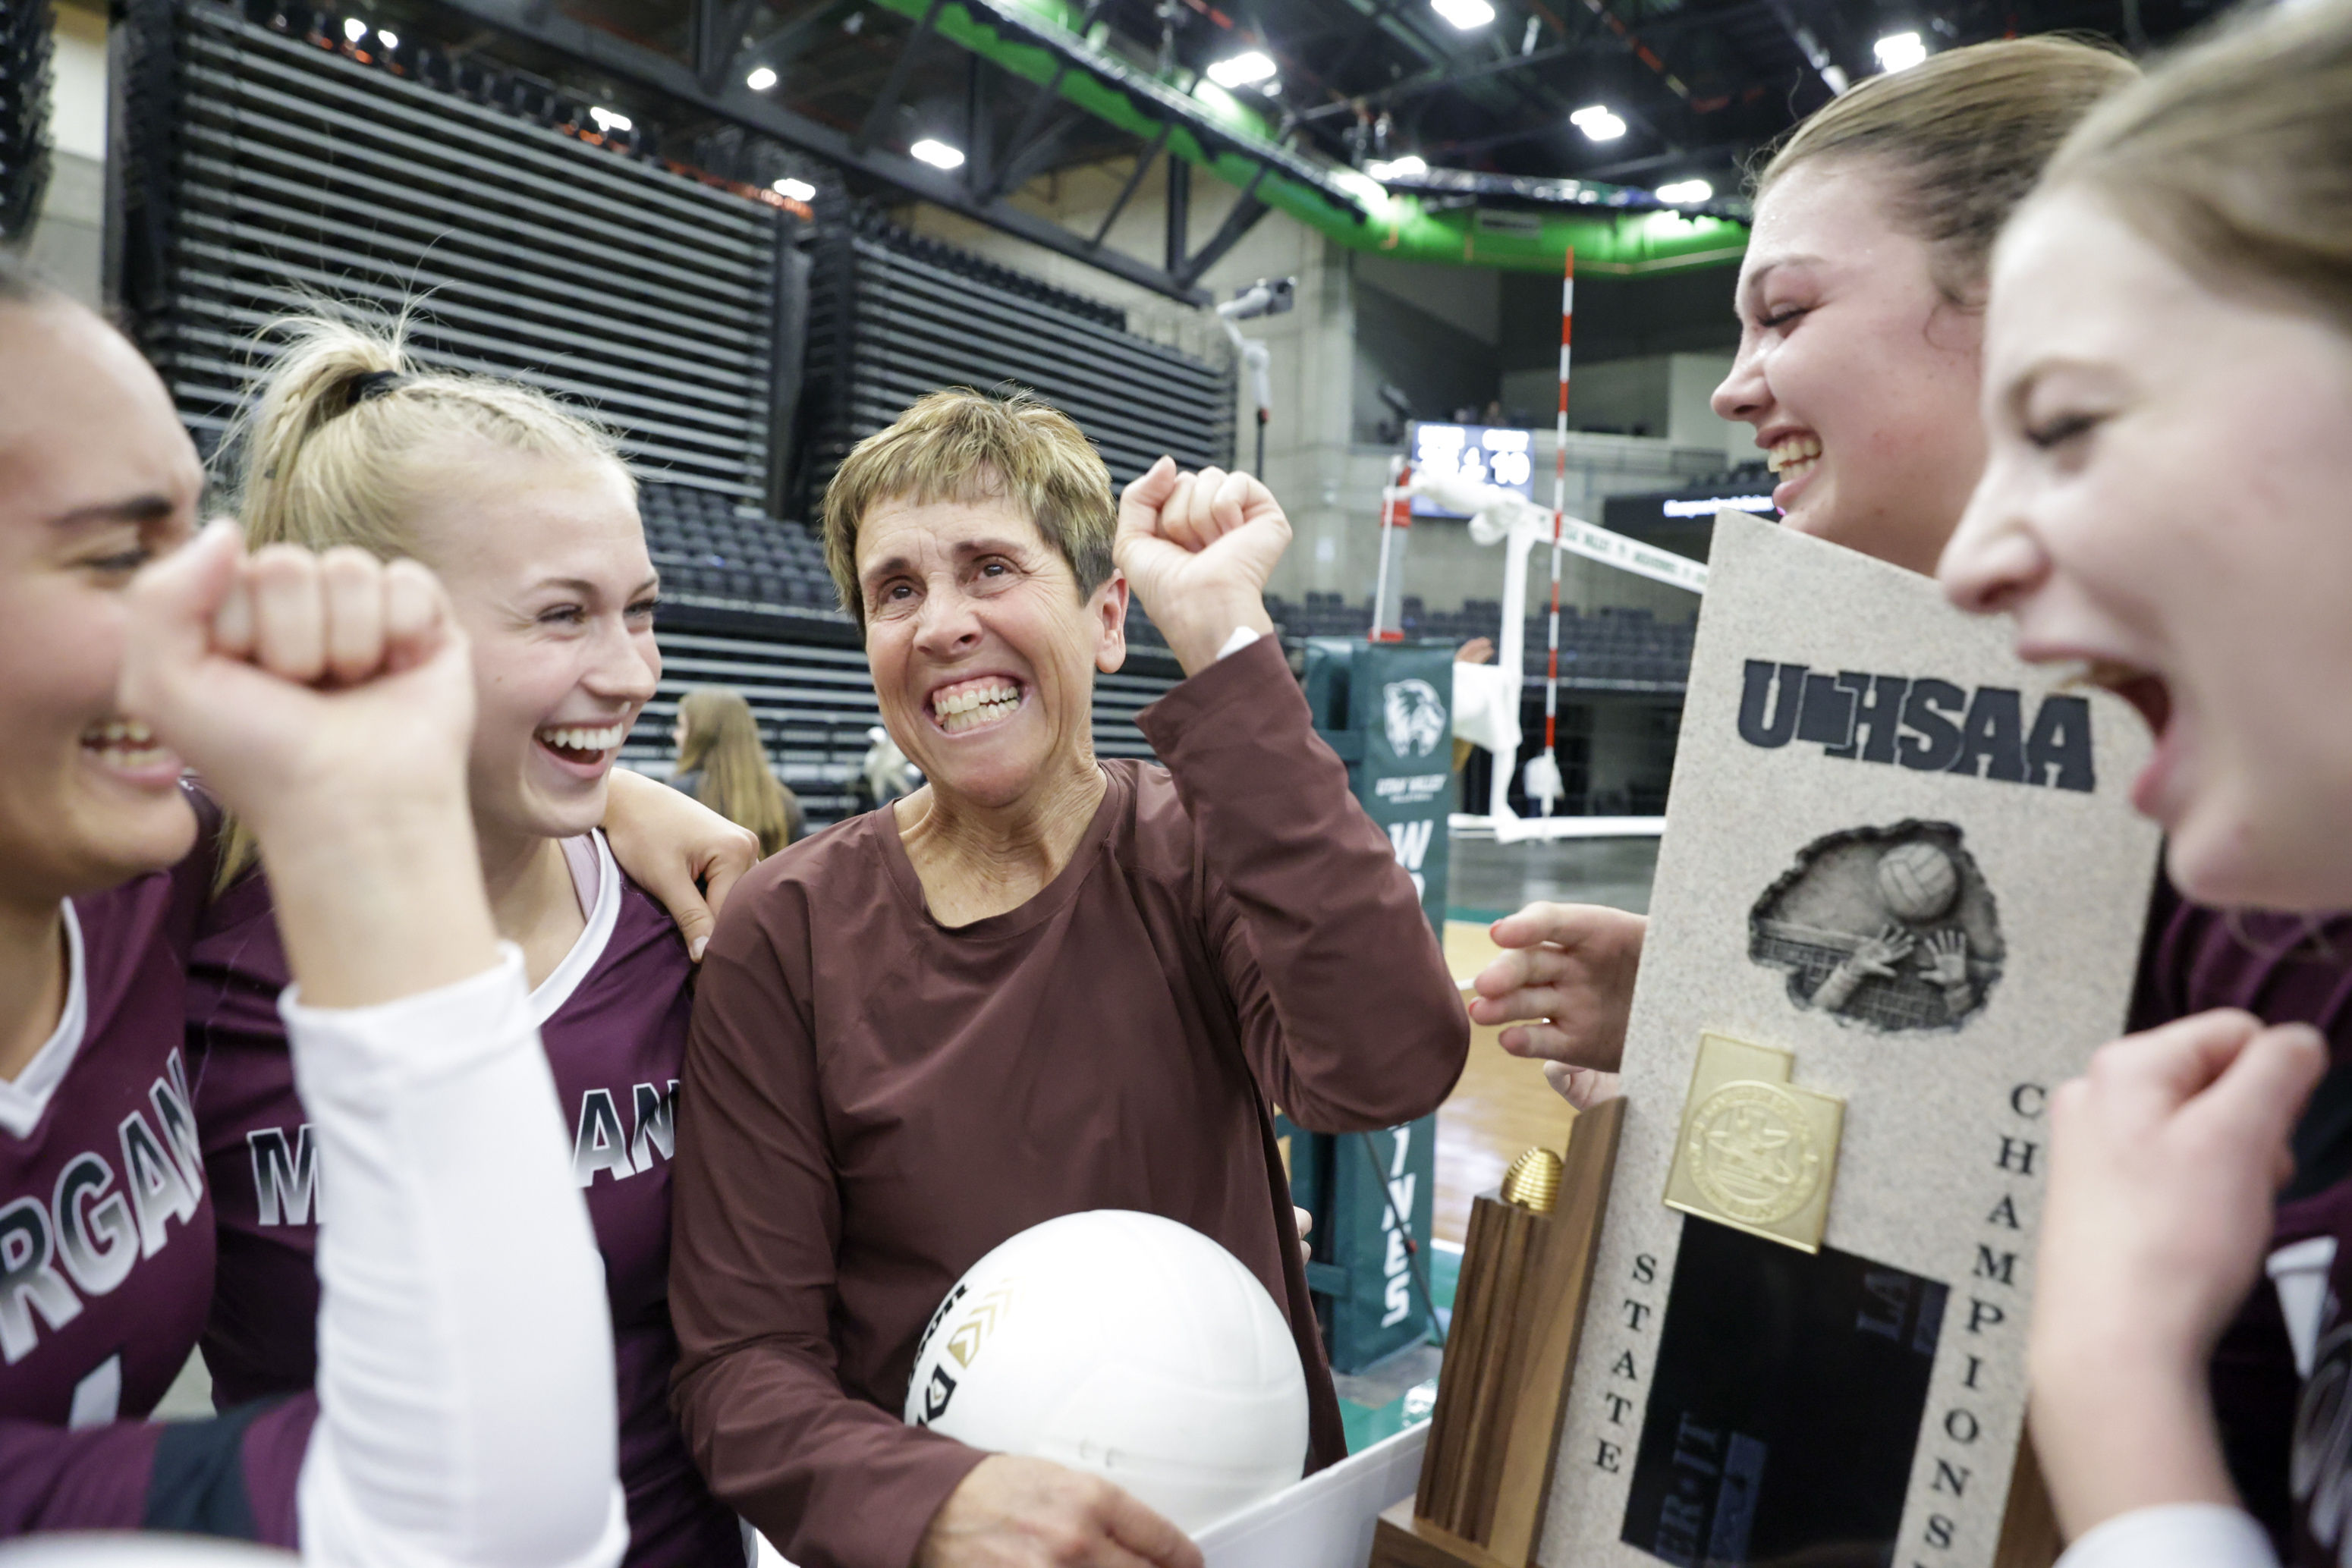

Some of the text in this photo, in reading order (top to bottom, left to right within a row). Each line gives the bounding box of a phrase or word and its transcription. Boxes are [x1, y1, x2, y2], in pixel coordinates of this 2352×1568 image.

[1738, 659, 2095, 793] UHSAA
[246, 1079, 680, 1227] MAN
[1593, 1253, 1657, 1474] STATE
[1912, 1083, 2047, 1568] CHAMPIONS
